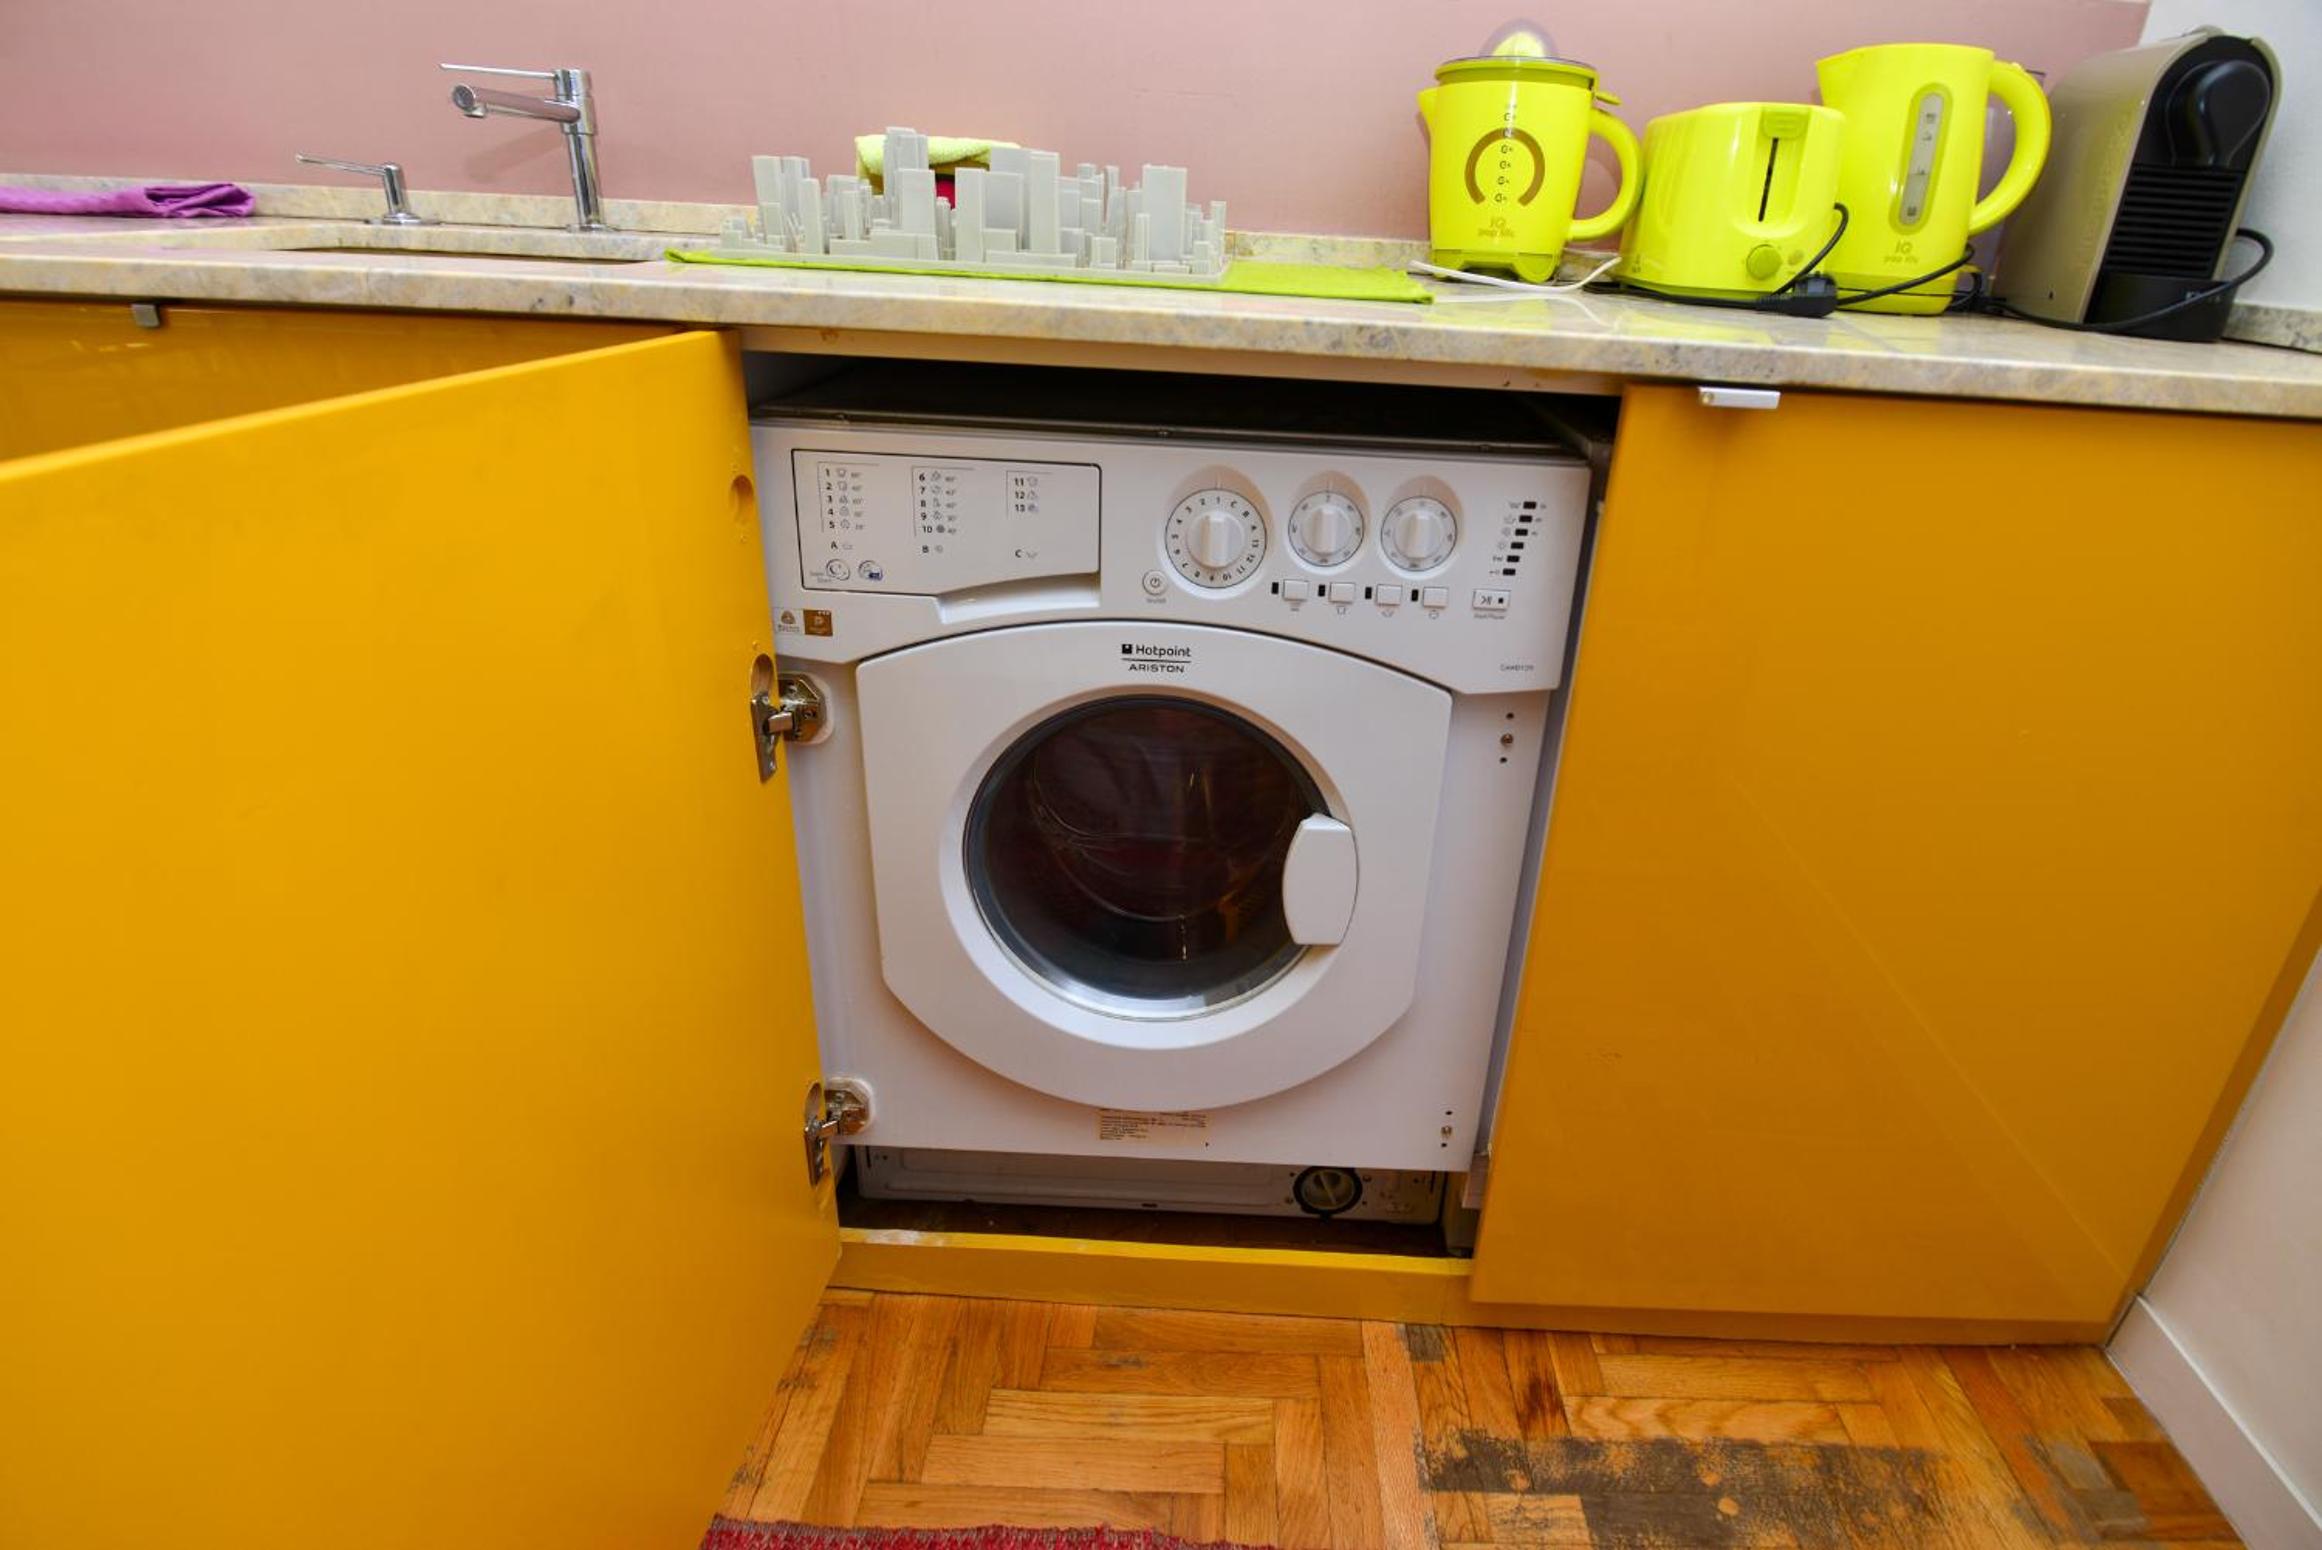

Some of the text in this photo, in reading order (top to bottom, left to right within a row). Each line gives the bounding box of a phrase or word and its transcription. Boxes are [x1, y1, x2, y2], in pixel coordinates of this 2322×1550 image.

[919, 473, 926, 482] 6
[1014, 477, 1024, 487] 11
[826, 482, 832, 491] 2
[920, 486, 926, 495] 7
[1015, 491, 1025, 500] 12
[828, 508, 834, 516] 4
[920, 512, 927, 521] 9
[829, 521, 835, 529] 5
[922, 525, 933, 534] 10
[830, 540, 838, 550] A
[1015, 549, 1022, 558] C
[1136, 644, 1191, 658] Hotpoint
[1128, 664, 1185, 673] ARISTON
